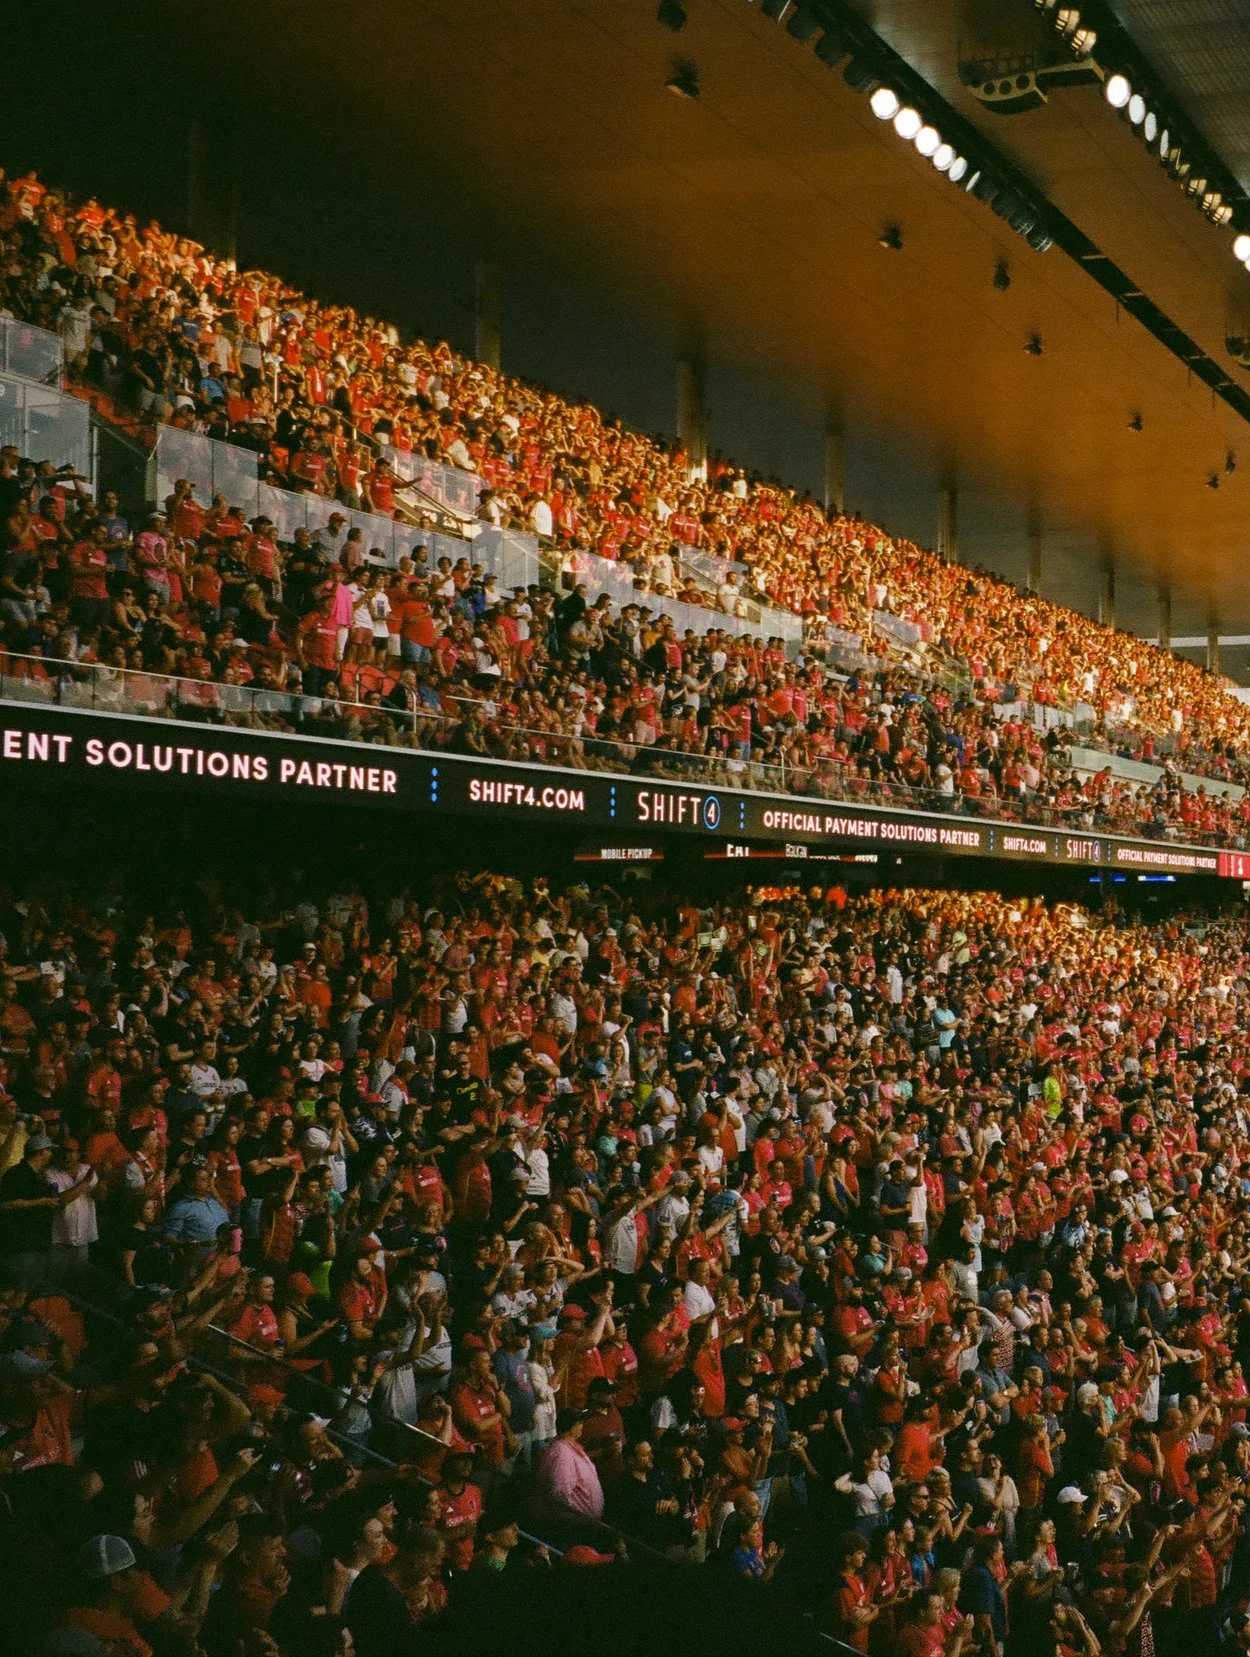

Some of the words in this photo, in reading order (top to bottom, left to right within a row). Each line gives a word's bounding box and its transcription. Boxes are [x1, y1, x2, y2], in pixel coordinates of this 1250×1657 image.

[4, 730, 72, 762] ENT
[86, 739, 268, 781] SOLUTIONS
[280, 758, 397, 793] PARTNER
[470, 780, 584, 810] SHIFT4.COM
[763, 811, 821, 832] OFFICIAL
[825, 817, 879, 838] PAYMENT
[880, 823, 938, 843] SOLUTIONS
[939, 829, 980, 847] PARTNER
[601, 848, 626, 860] MOBILE
[627, 848, 653, 860] PICKUP
[1003, 837, 1046, 854] SHIFT4.COM
[1118, 848, 1143, 862] OFFICIAL
[1144, 851, 1167, 865] PAYMENT
[1168, 854, 1195, 867] SOLUTIONS
[1196, 857, 1217, 869] PARTNER
